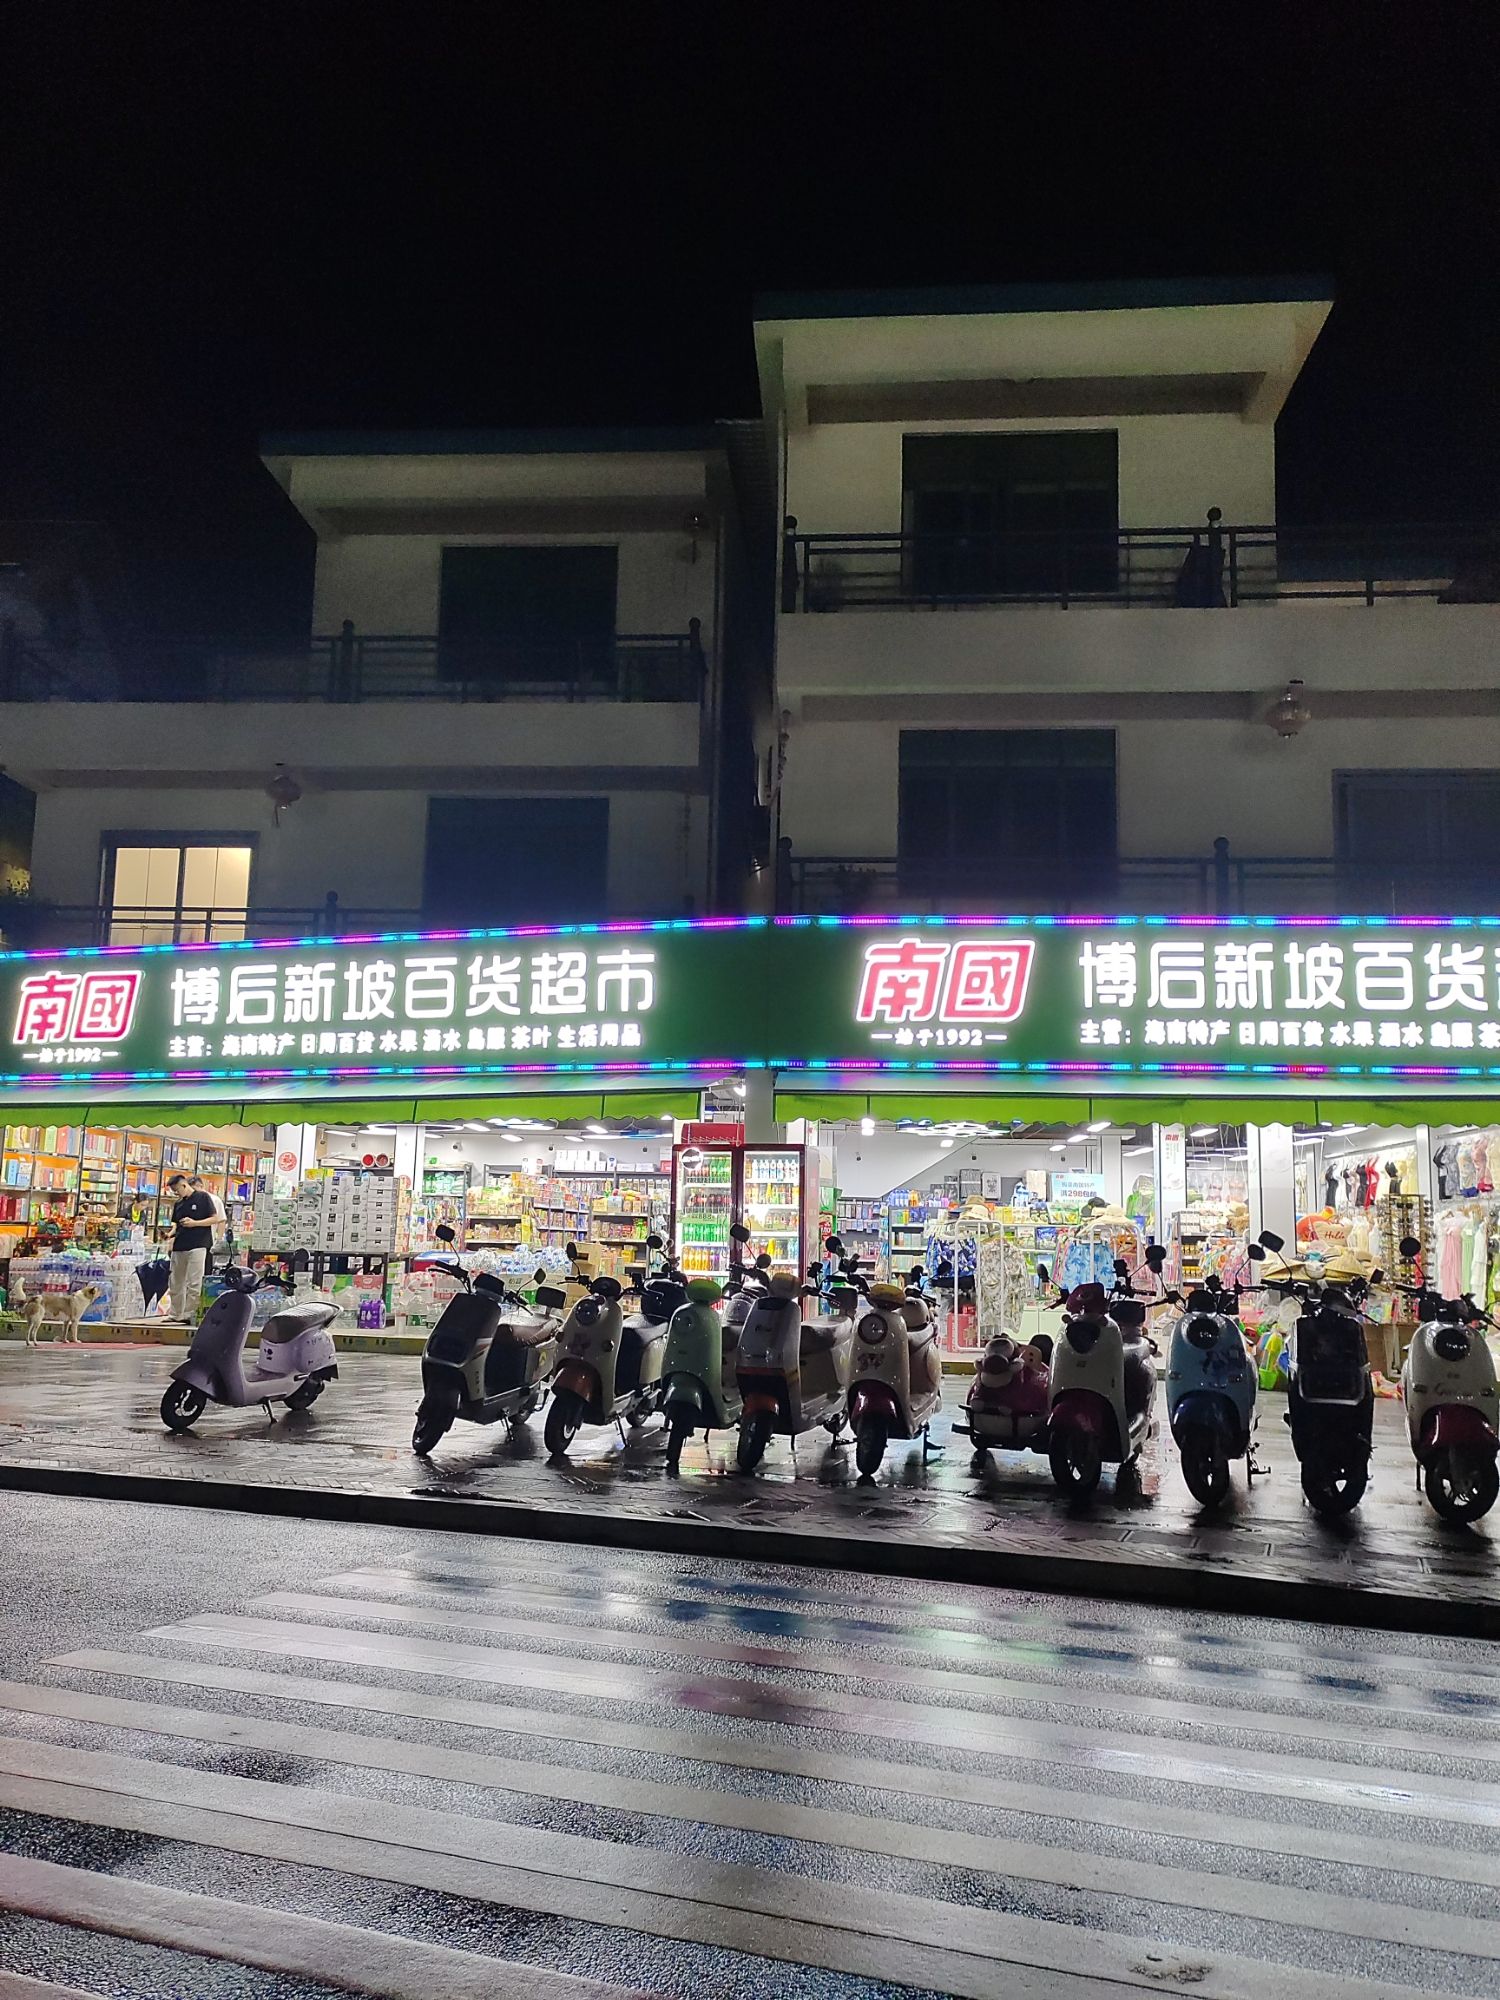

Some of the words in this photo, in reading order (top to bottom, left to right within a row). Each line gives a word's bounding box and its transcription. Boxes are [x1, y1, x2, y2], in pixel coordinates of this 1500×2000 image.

[170, 947, 656, 1026] 博后新坡百货超市
[1078, 941, 1500, 1011] 博后新坡百货
[221, 1032, 296, 1057] 海南特产
[301, 1030, 376, 1055] 日用百货
[378, 1029, 418, 1053] 水果
[510, 1024, 552, 1050] 茶叶
[557, 1022, 641, 1049] 生活用品
[1144, 1018, 1231, 1046] 海南特产
[1238, 1020, 1325, 1047] 日用百货
[1329, 1020, 1375, 1047] 水果
